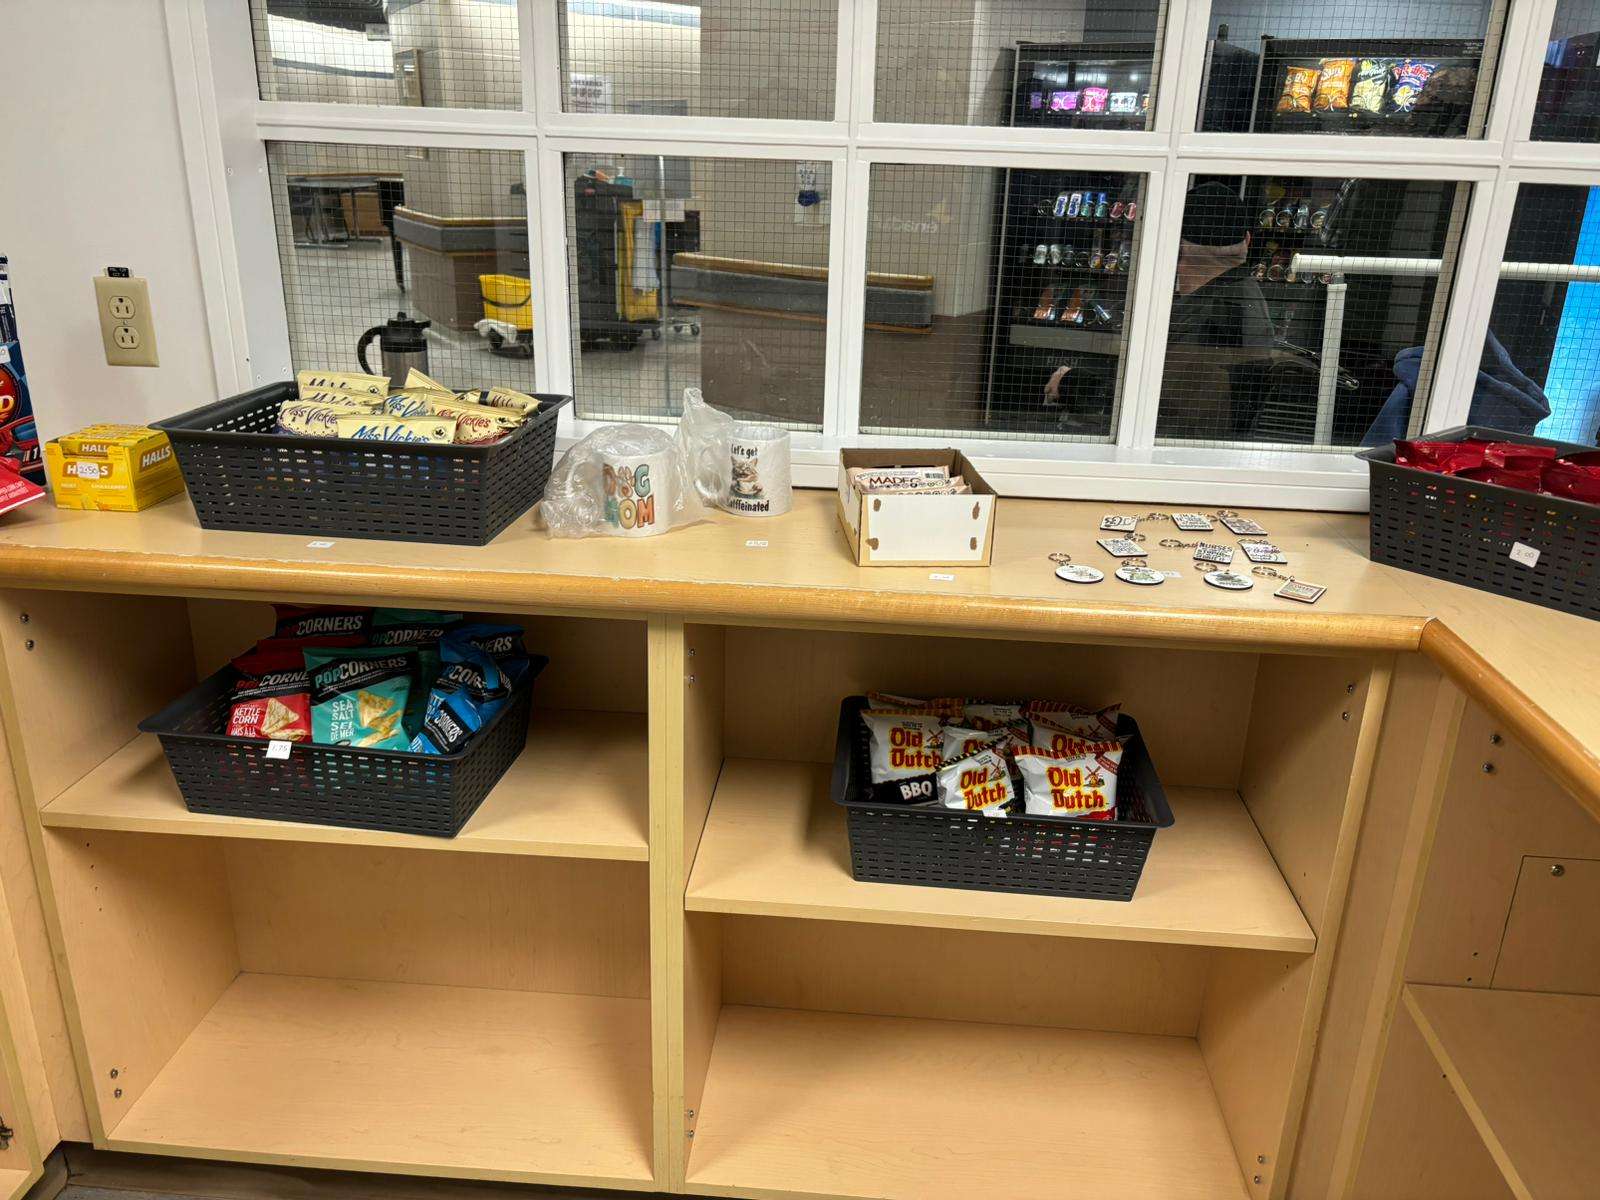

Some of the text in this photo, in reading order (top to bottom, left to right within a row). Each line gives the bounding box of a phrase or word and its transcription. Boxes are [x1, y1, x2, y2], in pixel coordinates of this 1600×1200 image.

[352, 425, 430, 443] Miss Vickie's
[81, 444, 109, 453] HALL
[142, 445, 171, 467] HALLS
[745, 446, 758, 458] get
[315, 656, 407, 689] POPCORNERS
[234, 707, 261, 717] KETTLE
[332, 699, 354, 713] SEA
[332, 710, 354, 721] SALT
[232, 715, 259, 725] CORN
[890, 726, 923, 748] Old
[891, 747, 942, 769] Dutch
[960, 767, 988, 789] Old
[1047, 767, 1081, 788] Old
[900, 780, 933, 800] BBQ
[964, 781, 1006, 809] Dutch
[1052, 788, 1105, 809] Dutch
